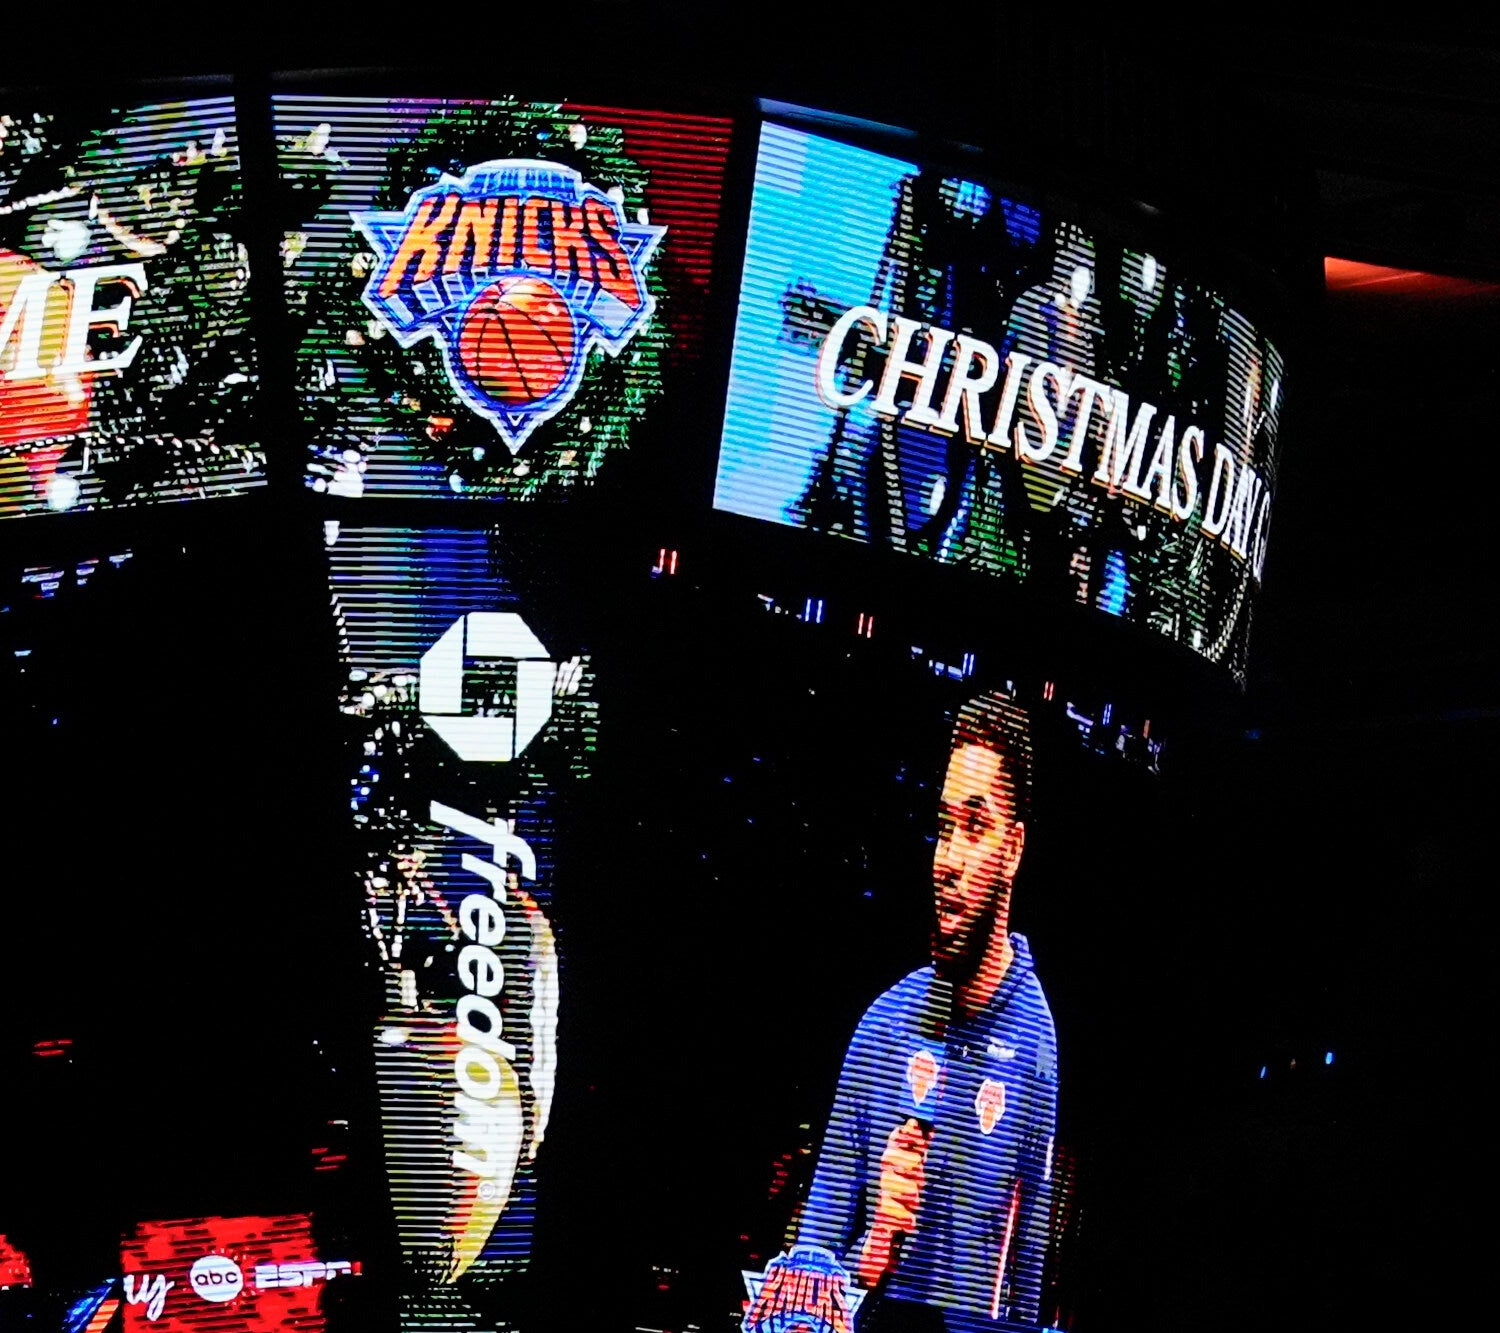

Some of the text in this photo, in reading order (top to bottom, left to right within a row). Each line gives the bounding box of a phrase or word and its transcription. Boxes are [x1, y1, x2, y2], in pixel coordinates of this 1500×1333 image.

[379, 192, 642, 309] KNICKS
[816, 305, 1204, 523] CHRISTMAS
[430, 800, 537, 1173] freedom
[194, 1270, 239, 1287] abc
